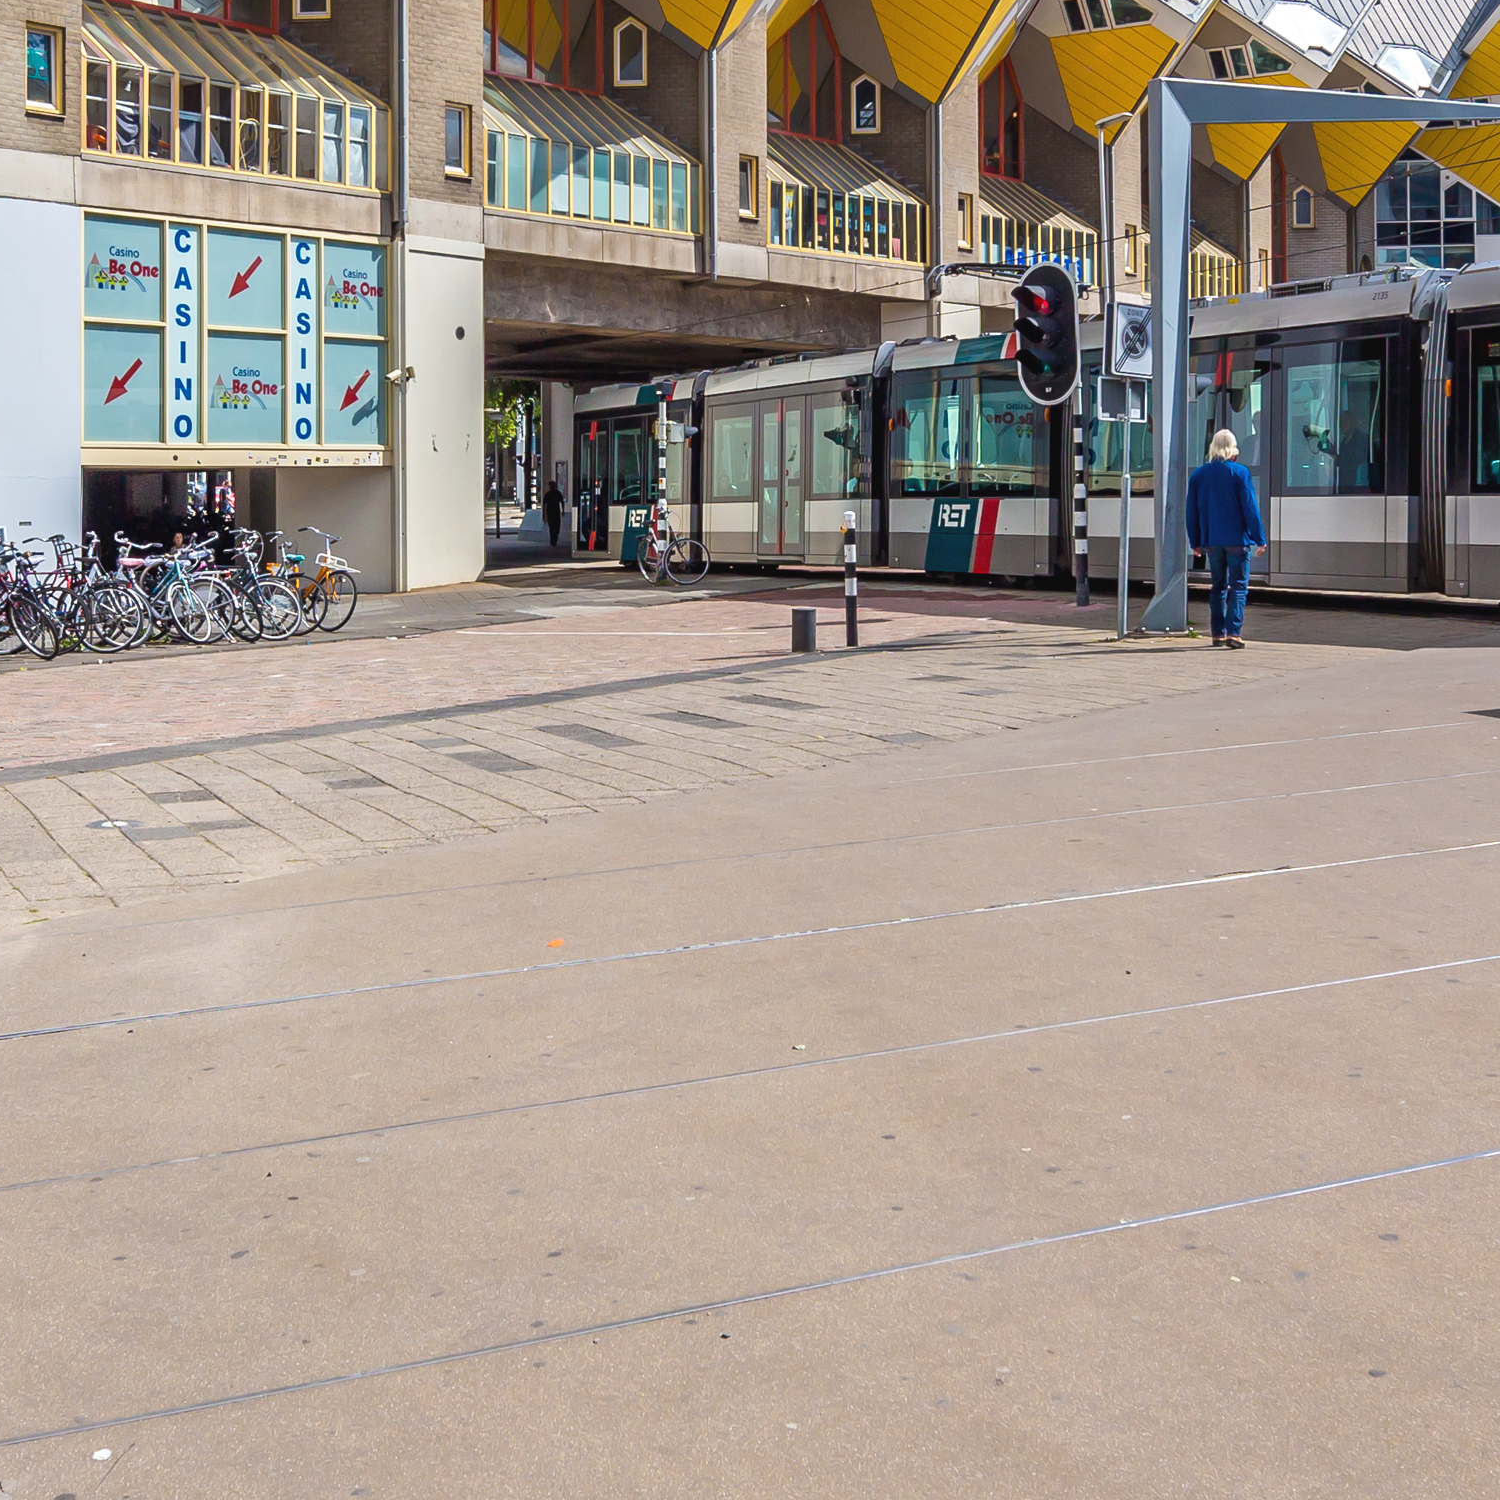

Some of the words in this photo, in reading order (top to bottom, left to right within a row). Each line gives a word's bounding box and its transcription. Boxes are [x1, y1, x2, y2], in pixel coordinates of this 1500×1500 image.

[109, 245, 140, 258] Casino
[109, 259, 126, 275] Be
[130, 261, 159, 278] One
[342, 268, 368, 279] Casino
[343, 280, 357, 295] Be
[360, 282, 384, 298] One
[173, 229, 193, 438] CASINO
[295, 241, 312, 440] CASINO
[232, 366, 261, 377] Casino
[232, 379, 248, 394] Be
[251, 380, 278, 395] One
[628, 509, 648, 528] RET
[938, 503, 971, 528] RET
